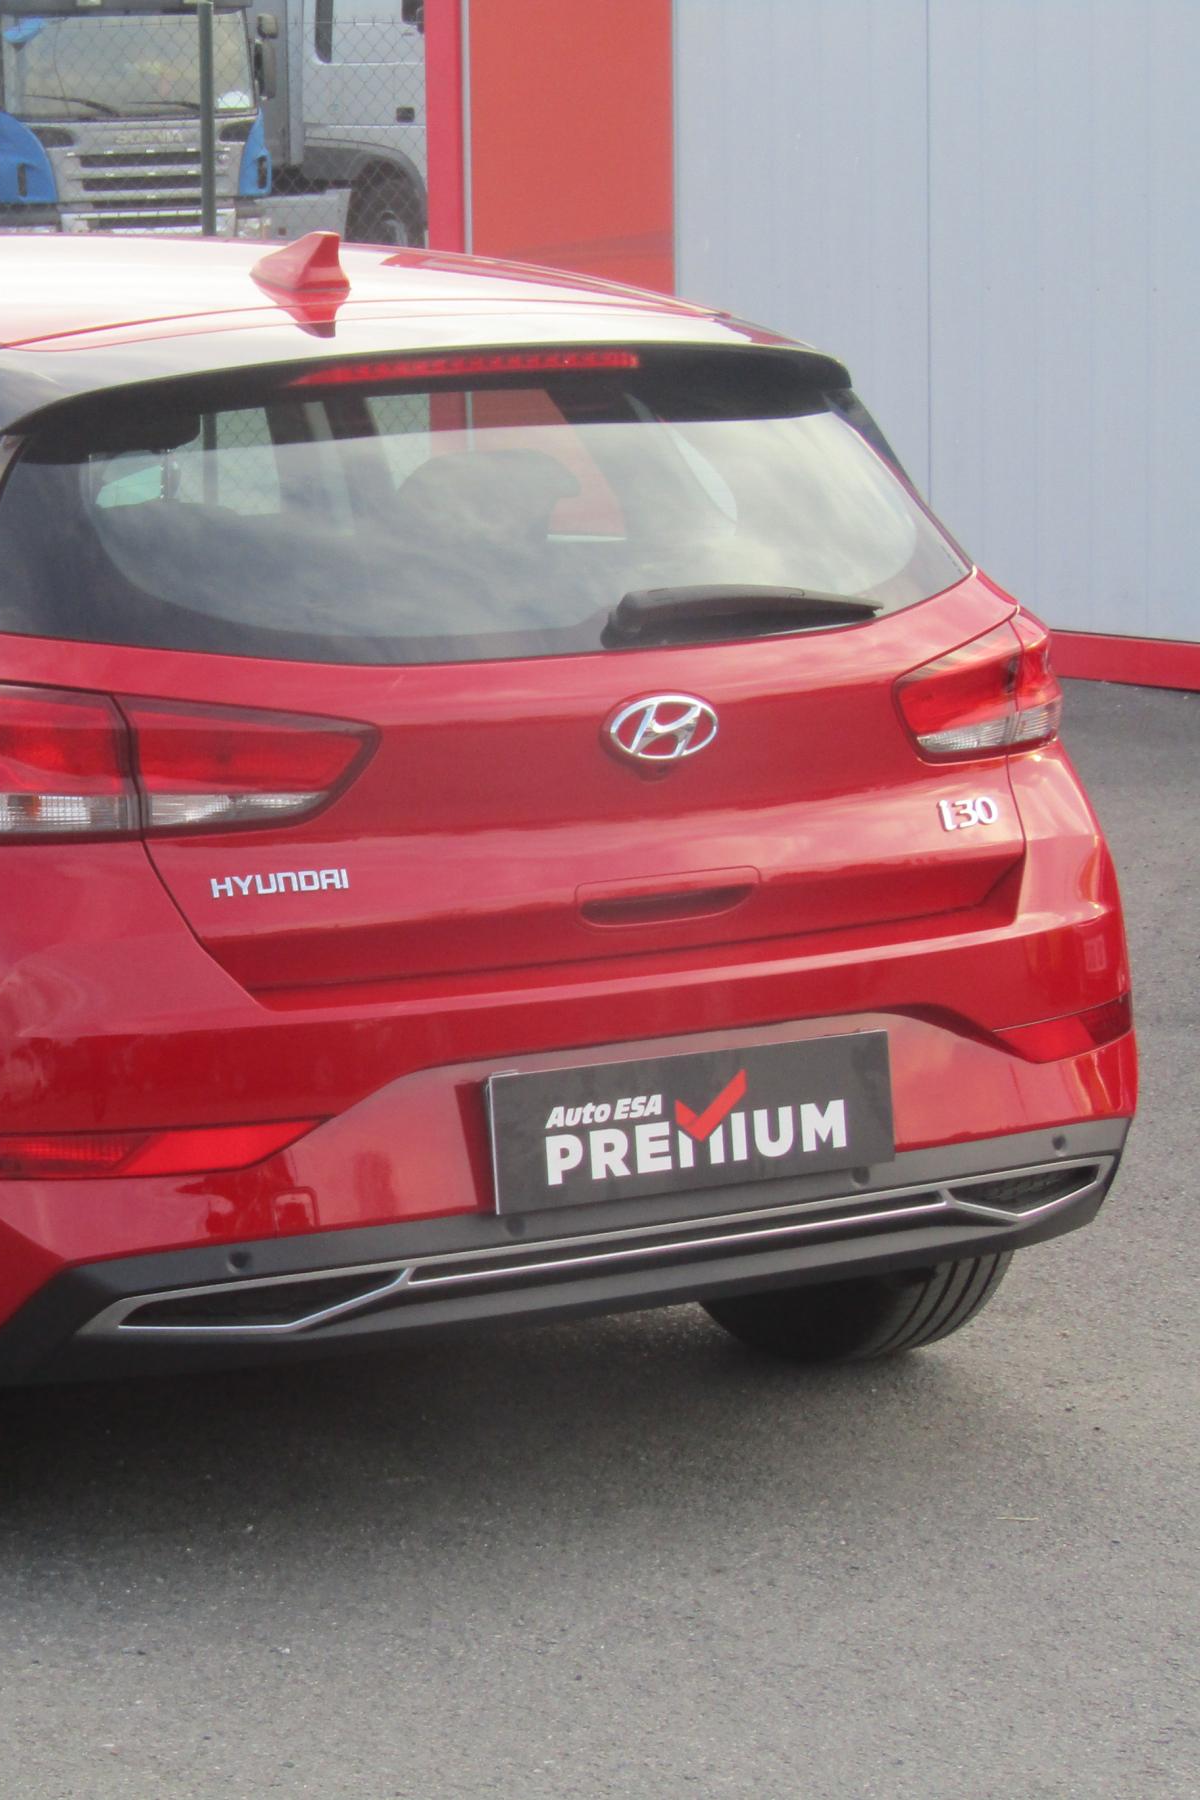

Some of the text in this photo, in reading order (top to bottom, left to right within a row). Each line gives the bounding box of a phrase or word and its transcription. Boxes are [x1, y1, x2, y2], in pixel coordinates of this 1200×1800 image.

[937, 796, 998, 832] i30
[210, 868, 349, 898] HYUNDAI
[545, 1094, 663, 1129] Auto ESA
[545, 1099, 848, 1186] PREMIUM
